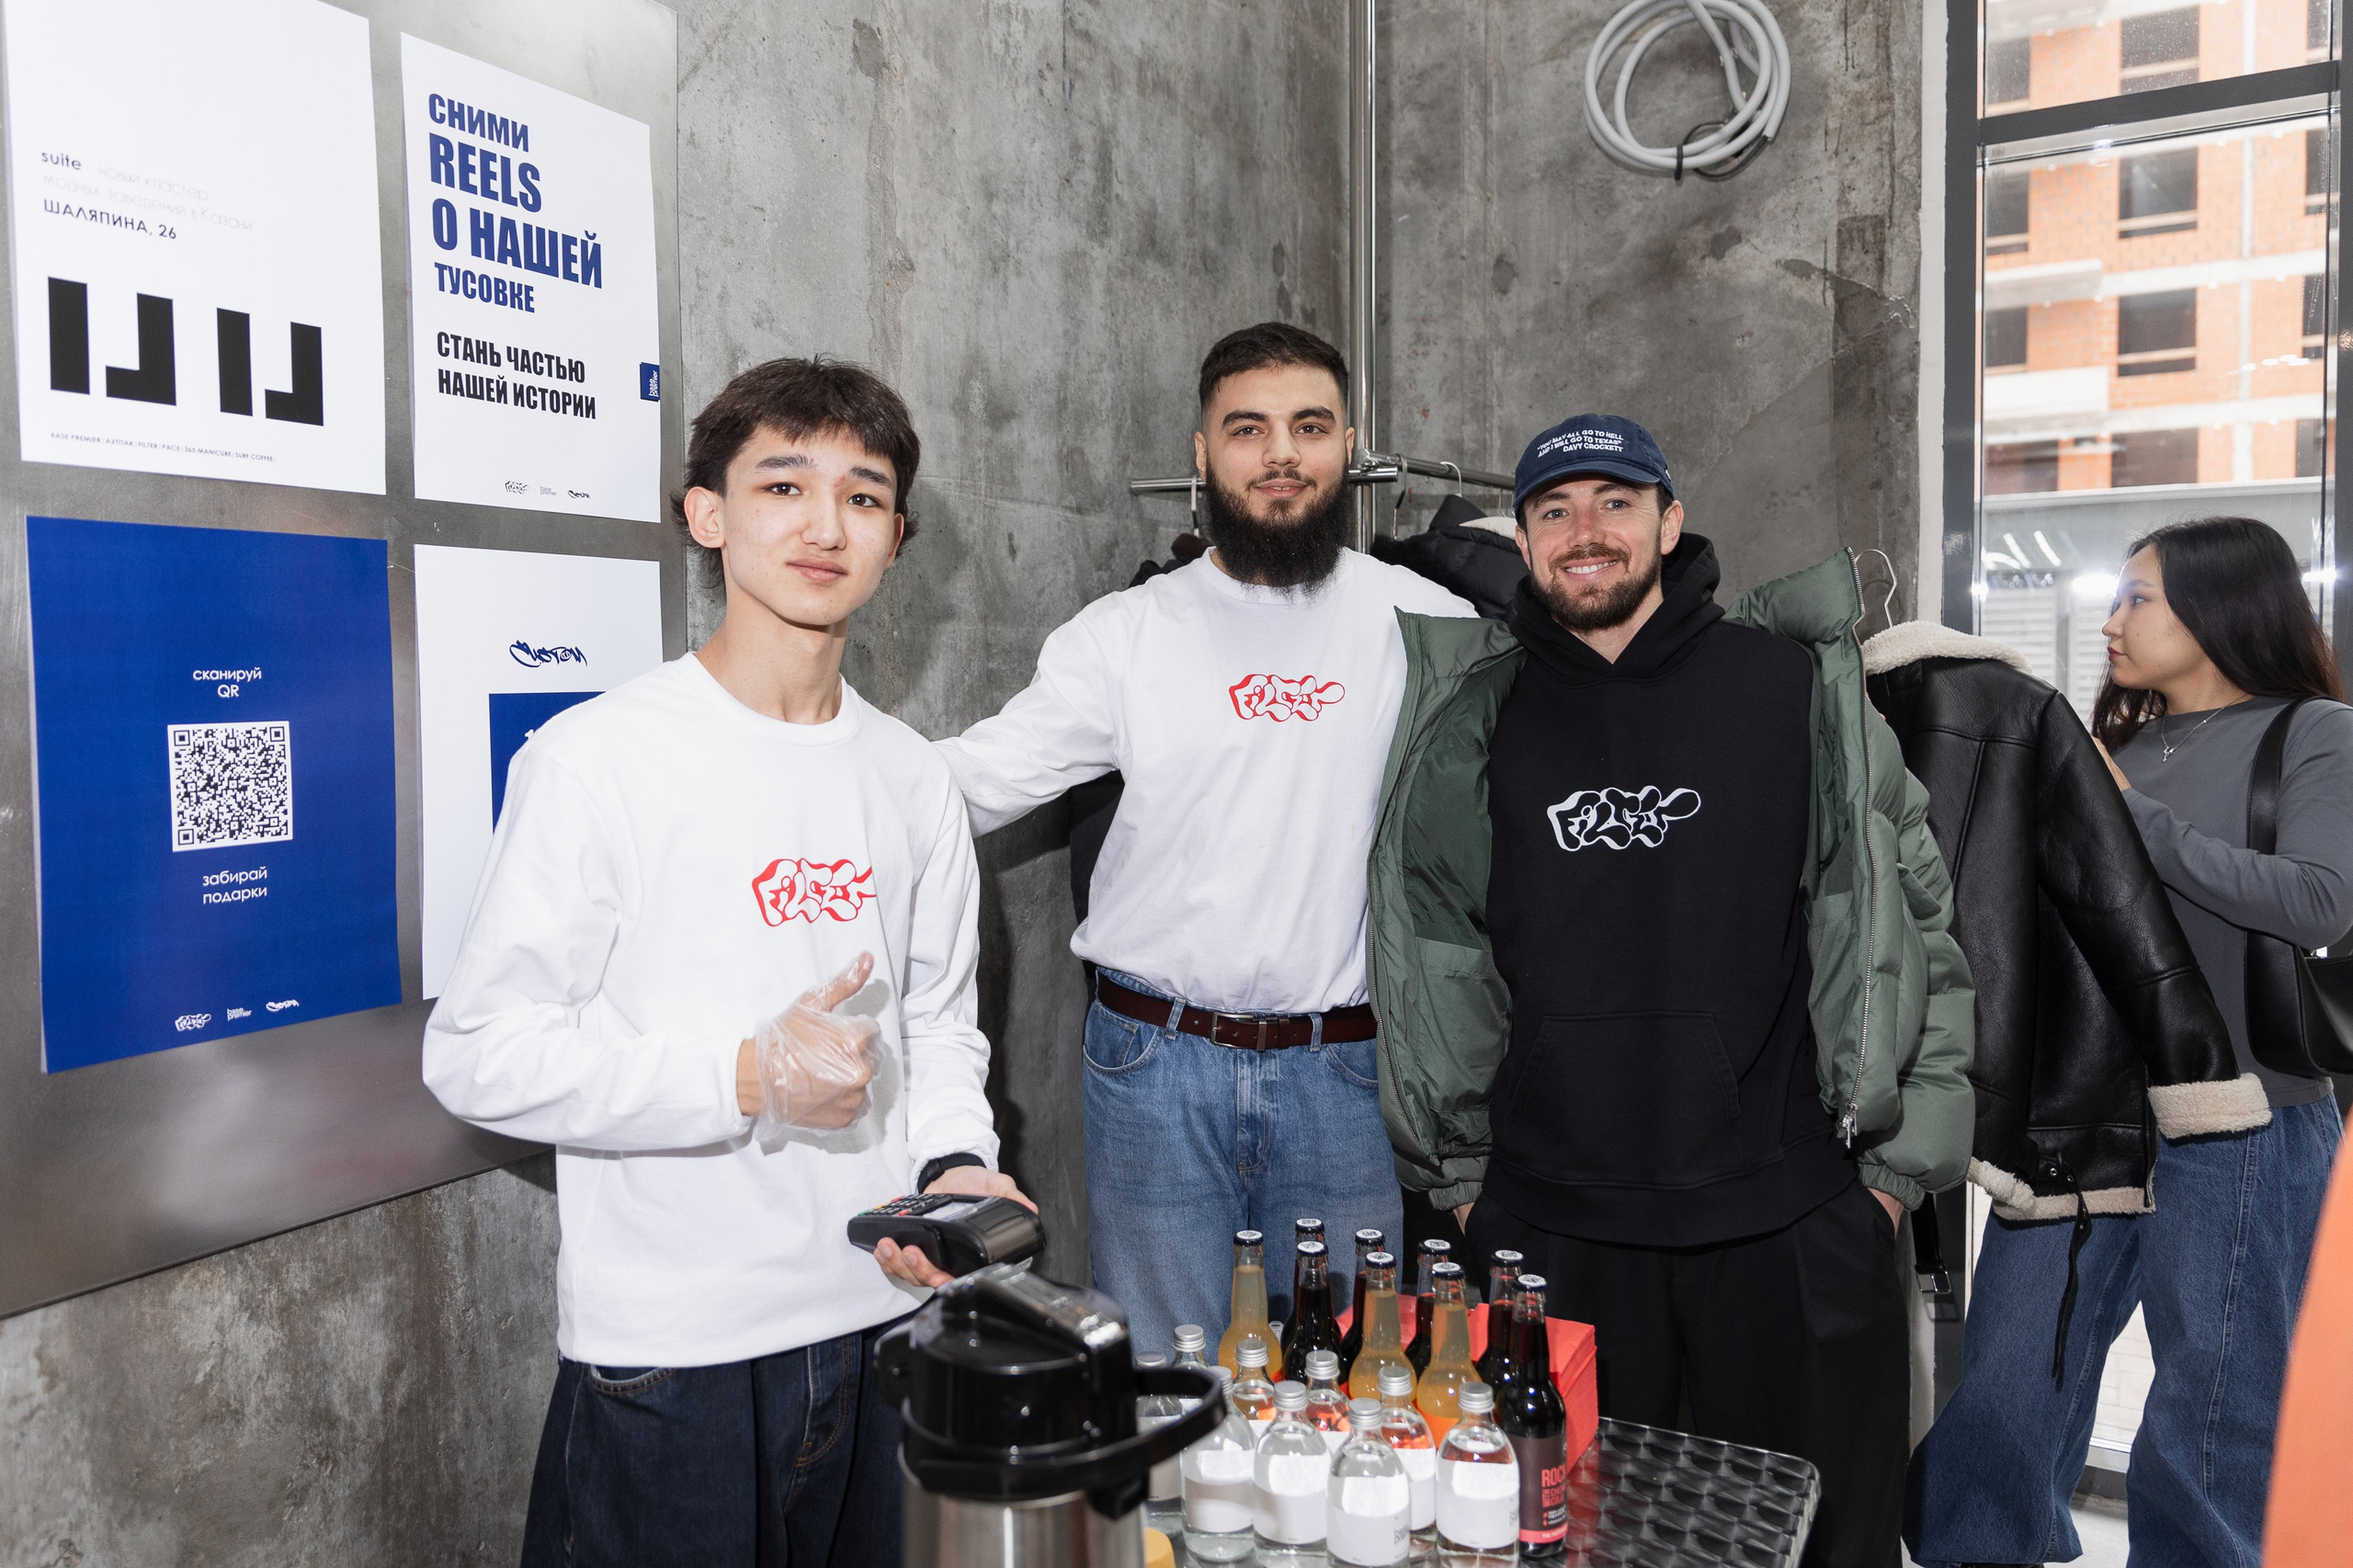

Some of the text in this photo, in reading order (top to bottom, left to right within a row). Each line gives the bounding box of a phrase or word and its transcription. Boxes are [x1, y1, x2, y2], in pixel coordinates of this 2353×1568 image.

[428, 93, 529, 153] СНИМИ
[41, 152, 210, 202] suite новый кластер
[428, 131, 542, 213] REELS
[43, 174, 100, 197] модных
[106, 187, 188, 217] заведений
[201, 207, 253, 232] Казани
[43, 199, 177, 240] ШАЛЯПИНА, 26
[432, 198, 602, 290] О НАШЕЙ
[434, 261, 535, 313] ТУСОВКЕ
[437, 331, 585, 383] СТАНЬ ЧАСТЬЮ
[438, 368, 597, 419] НАШЕЙ ИСТОРИИ
[51, 432, 69, 440] BASE
[71, 434, 101, 443] PREMIER
[138, 441, 158, 449] FILTER
[197, 448, 232, 458] MANICURE
[250, 453, 273, 462] COFFEE
[1563, 442, 1623, 452] DAVY CROCKETT
[1606, 431, 1624, 440] HELL
[192, 666, 262, 683] сканируй
[217, 684, 240, 699] QR
[202, 866, 267, 887] забирай
[202, 887, 267, 905] подарки
